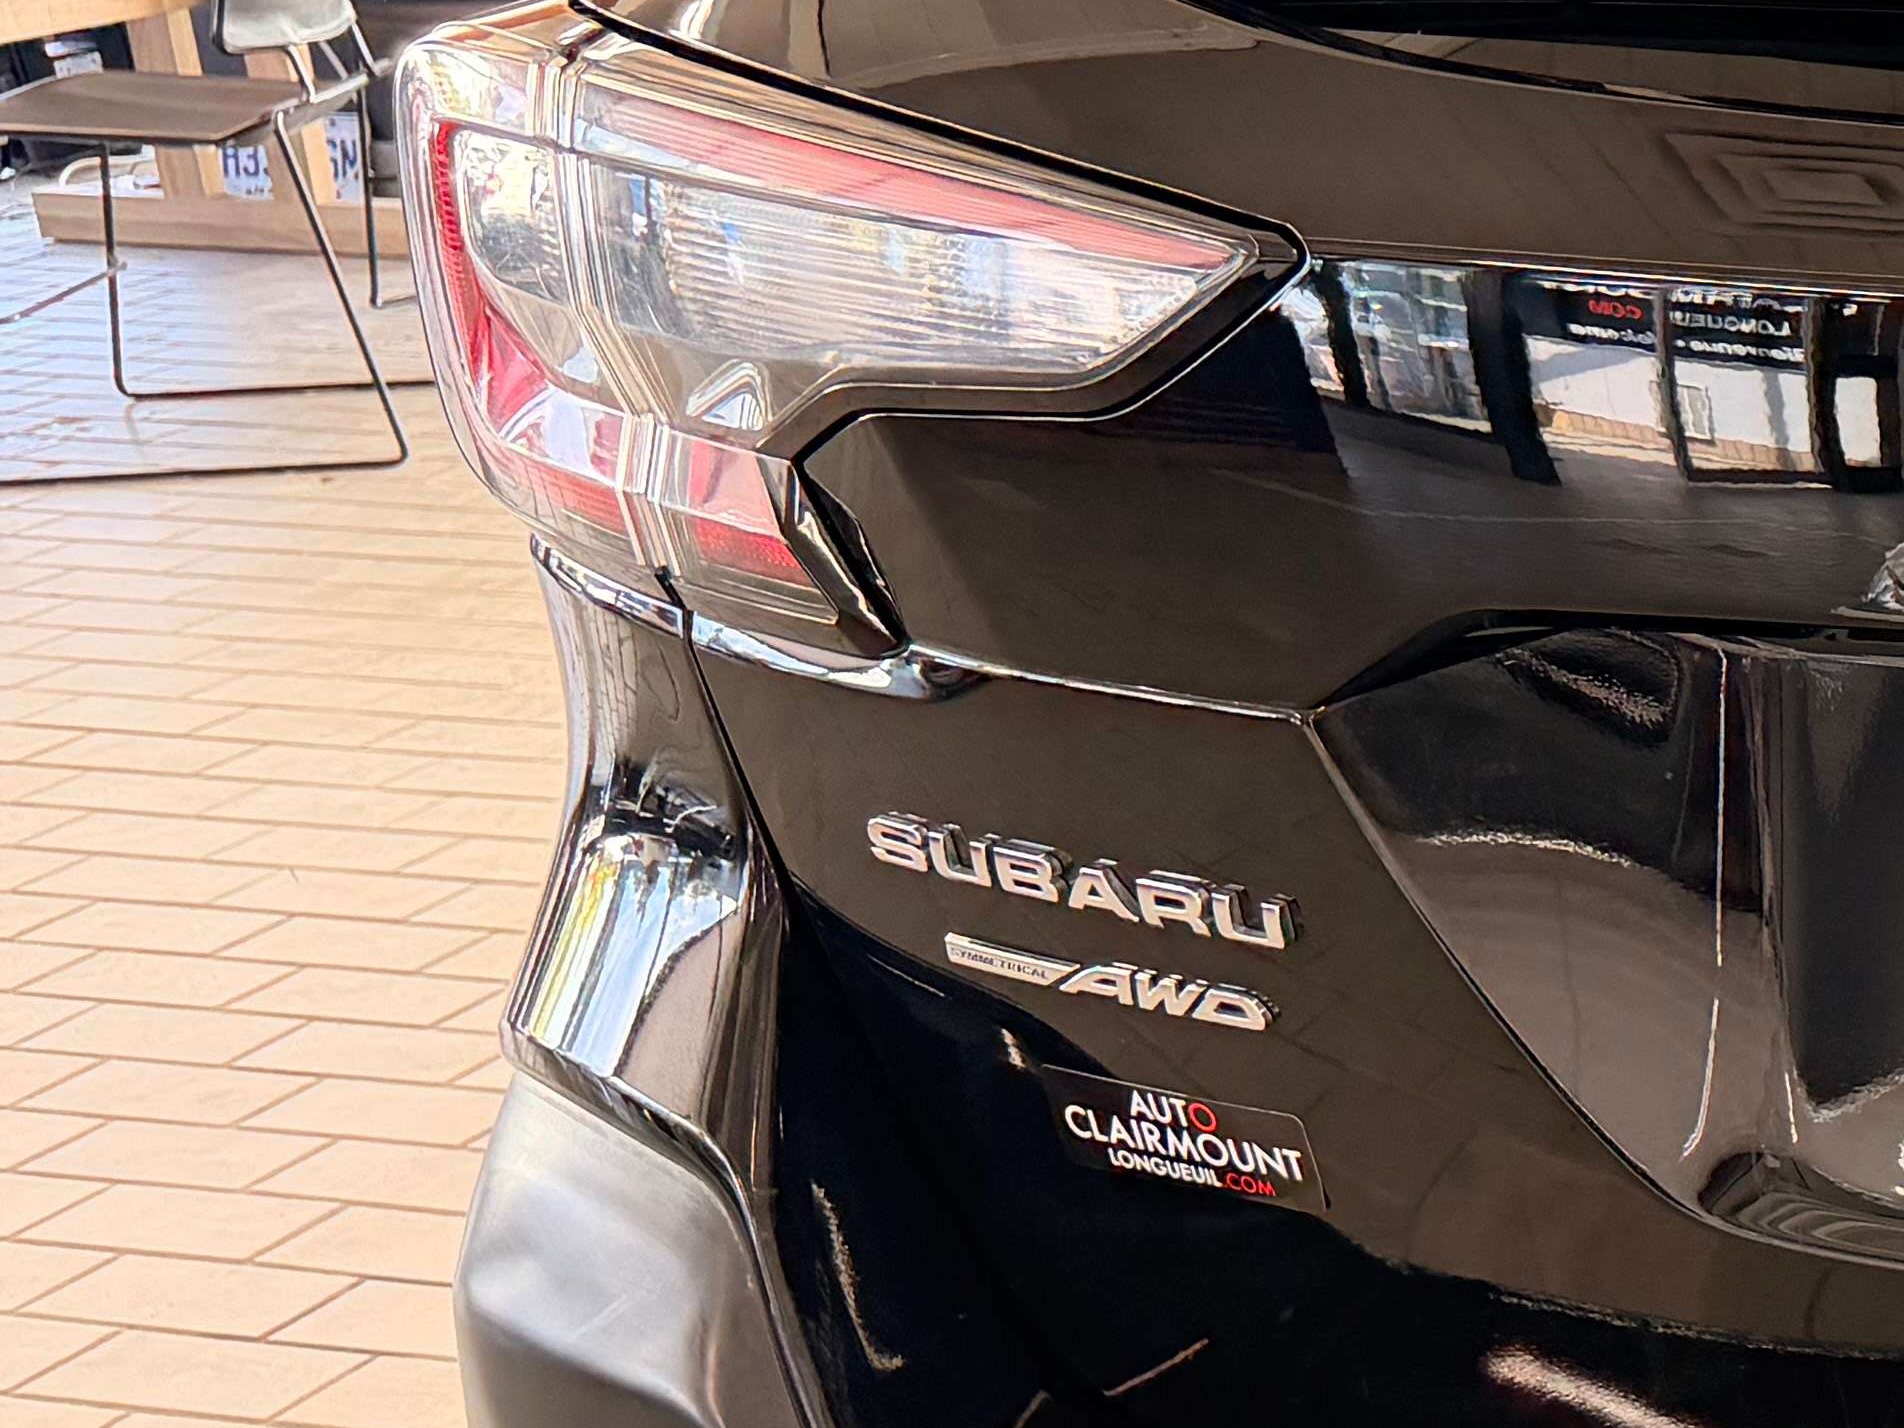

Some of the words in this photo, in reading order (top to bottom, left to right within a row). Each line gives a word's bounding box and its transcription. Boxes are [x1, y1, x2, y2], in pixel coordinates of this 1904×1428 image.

[866, 812, 1302, 949] SUBARU
[1059, 961, 1280, 1031] AWD
[1064, 1104, 1304, 1181] CLAIRMOUNT
[1130, 1089, 1218, 1133] AUTO
[1107, 1147, 1277, 1197] LONGUEUIL.COM
